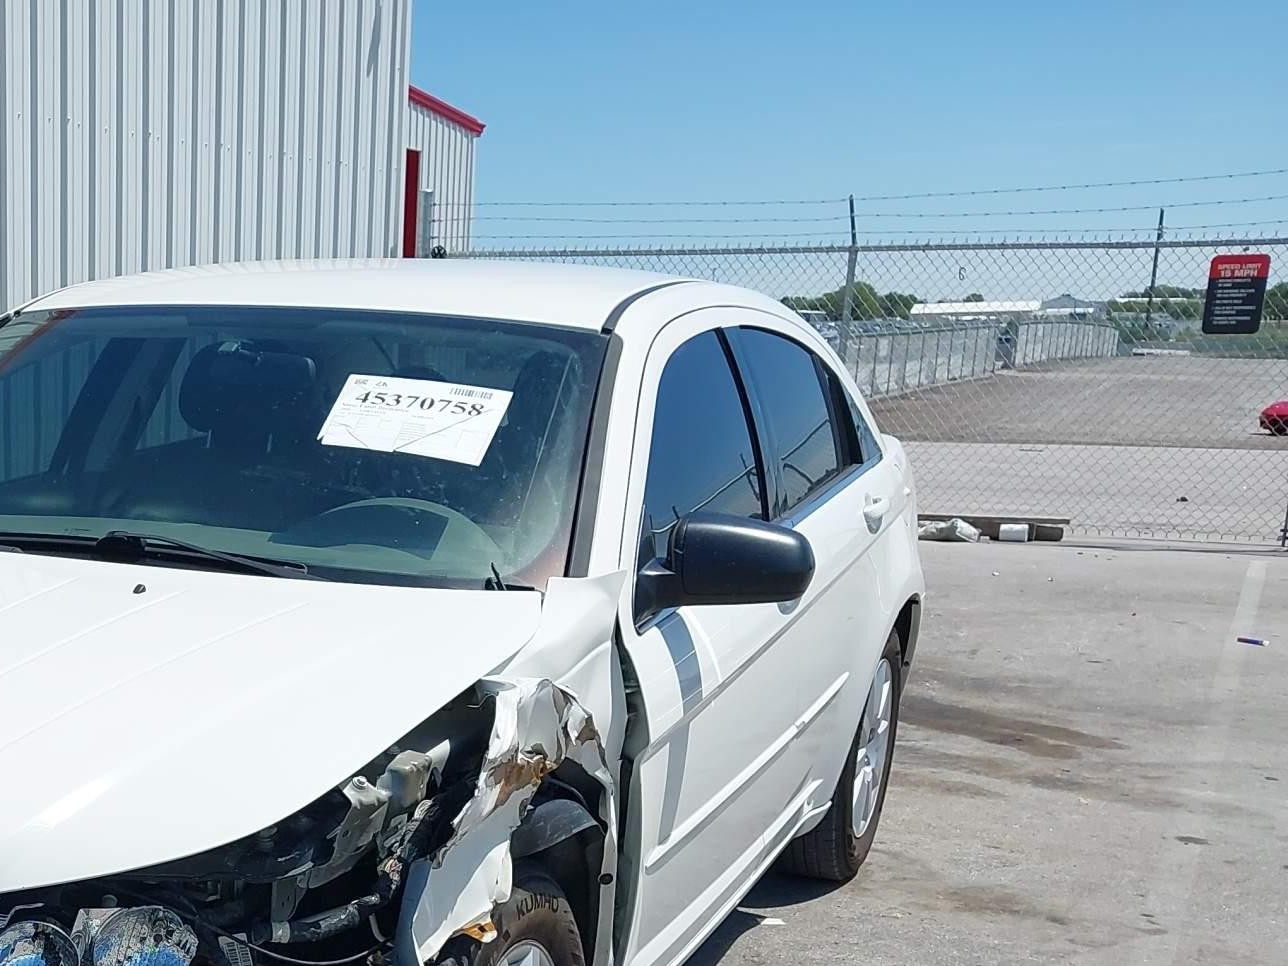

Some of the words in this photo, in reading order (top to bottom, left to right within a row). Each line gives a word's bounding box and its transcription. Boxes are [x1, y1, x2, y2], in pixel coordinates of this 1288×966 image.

[1220, 269, 1231, 278] 15
[1234, 269, 1258, 277] MPH
[355, 390, 485, 417] 45370758
[515, 893, 560, 921] KUMHO
